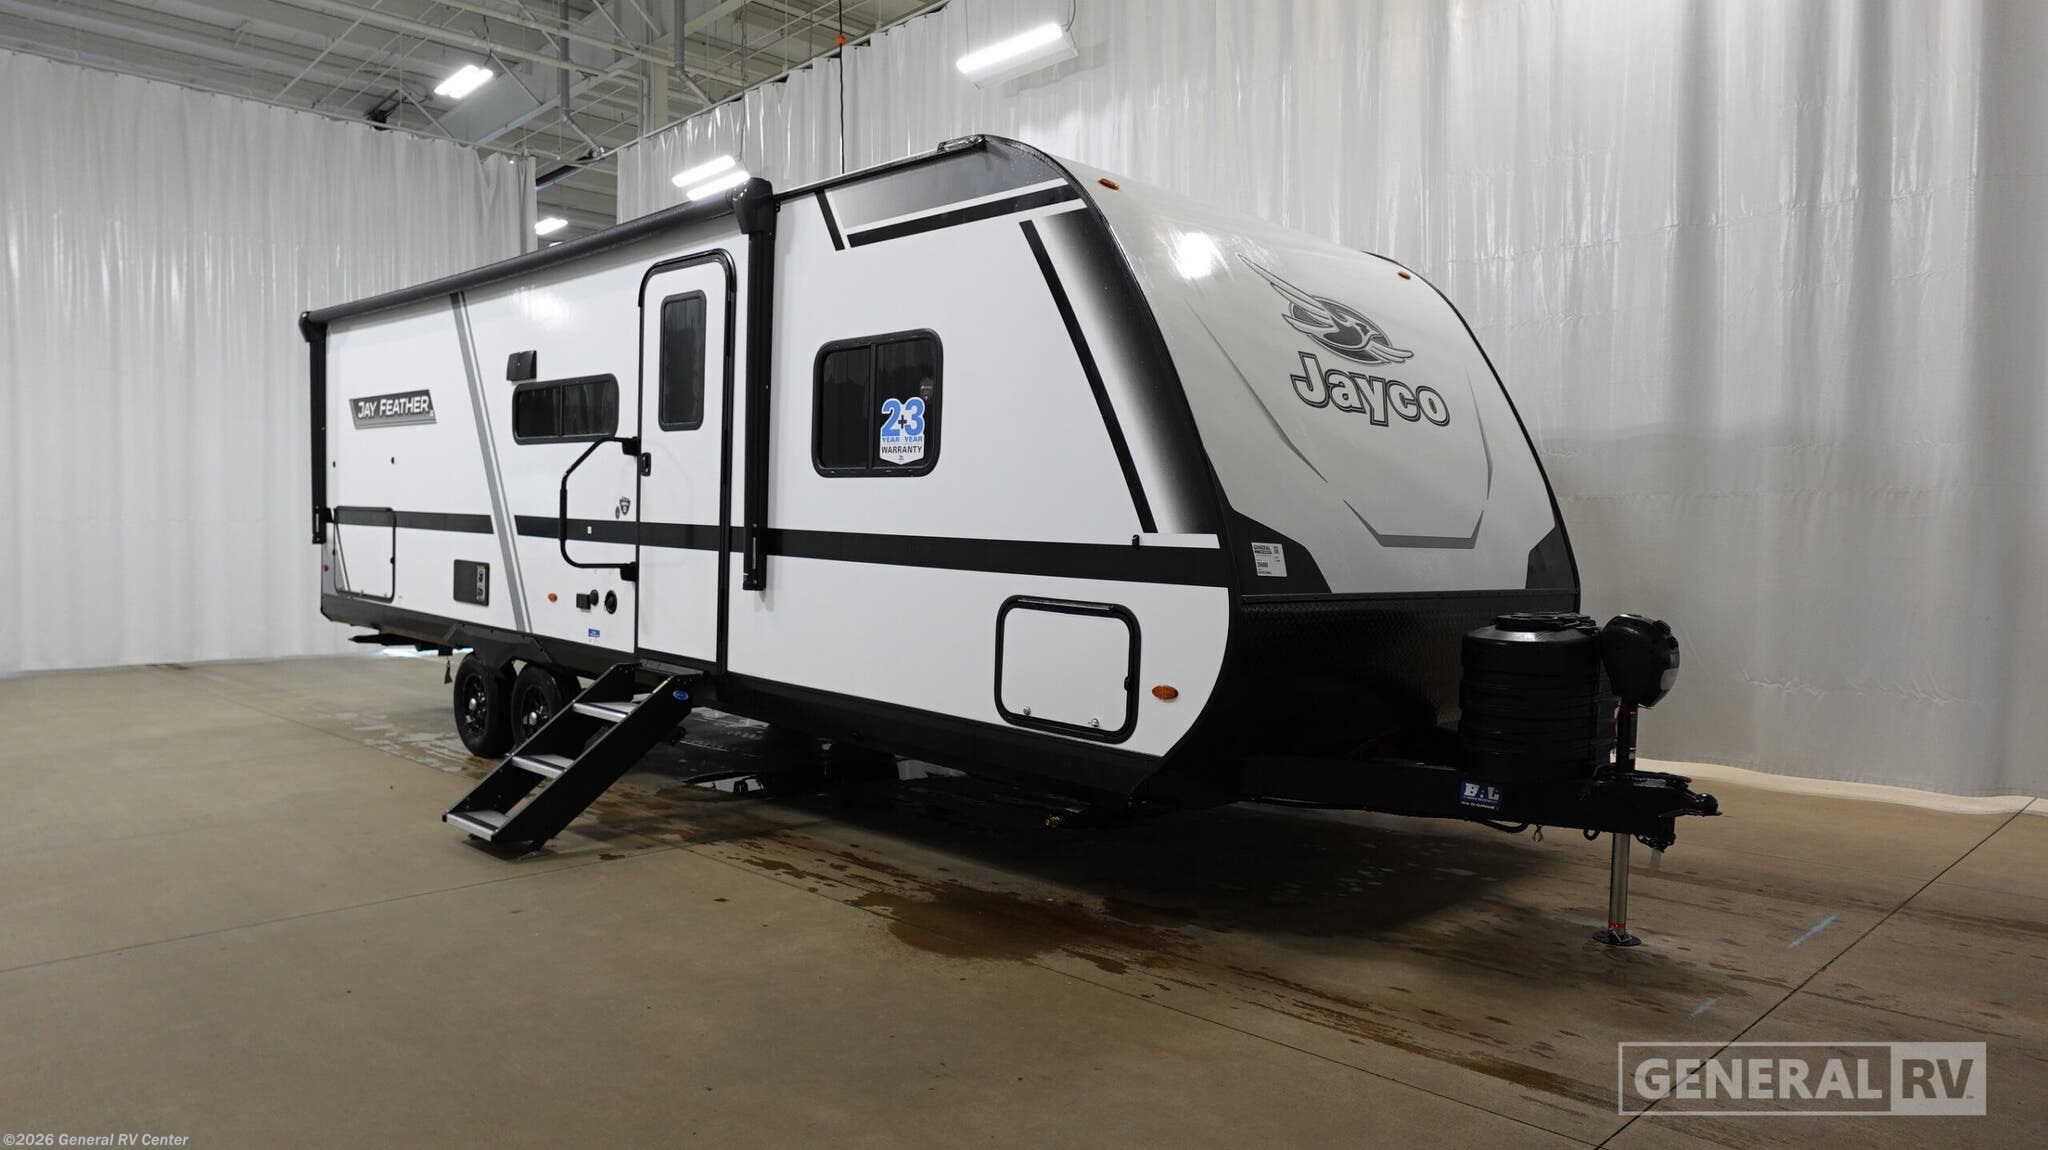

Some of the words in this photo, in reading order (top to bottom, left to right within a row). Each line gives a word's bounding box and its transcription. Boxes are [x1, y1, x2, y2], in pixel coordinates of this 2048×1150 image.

[1290, 351, 1451, 427] Jayco
[358, 401, 377, 418] JAY
[380, 396, 429, 416] FEATHER
[881, 445, 922, 454] WARRANTY
